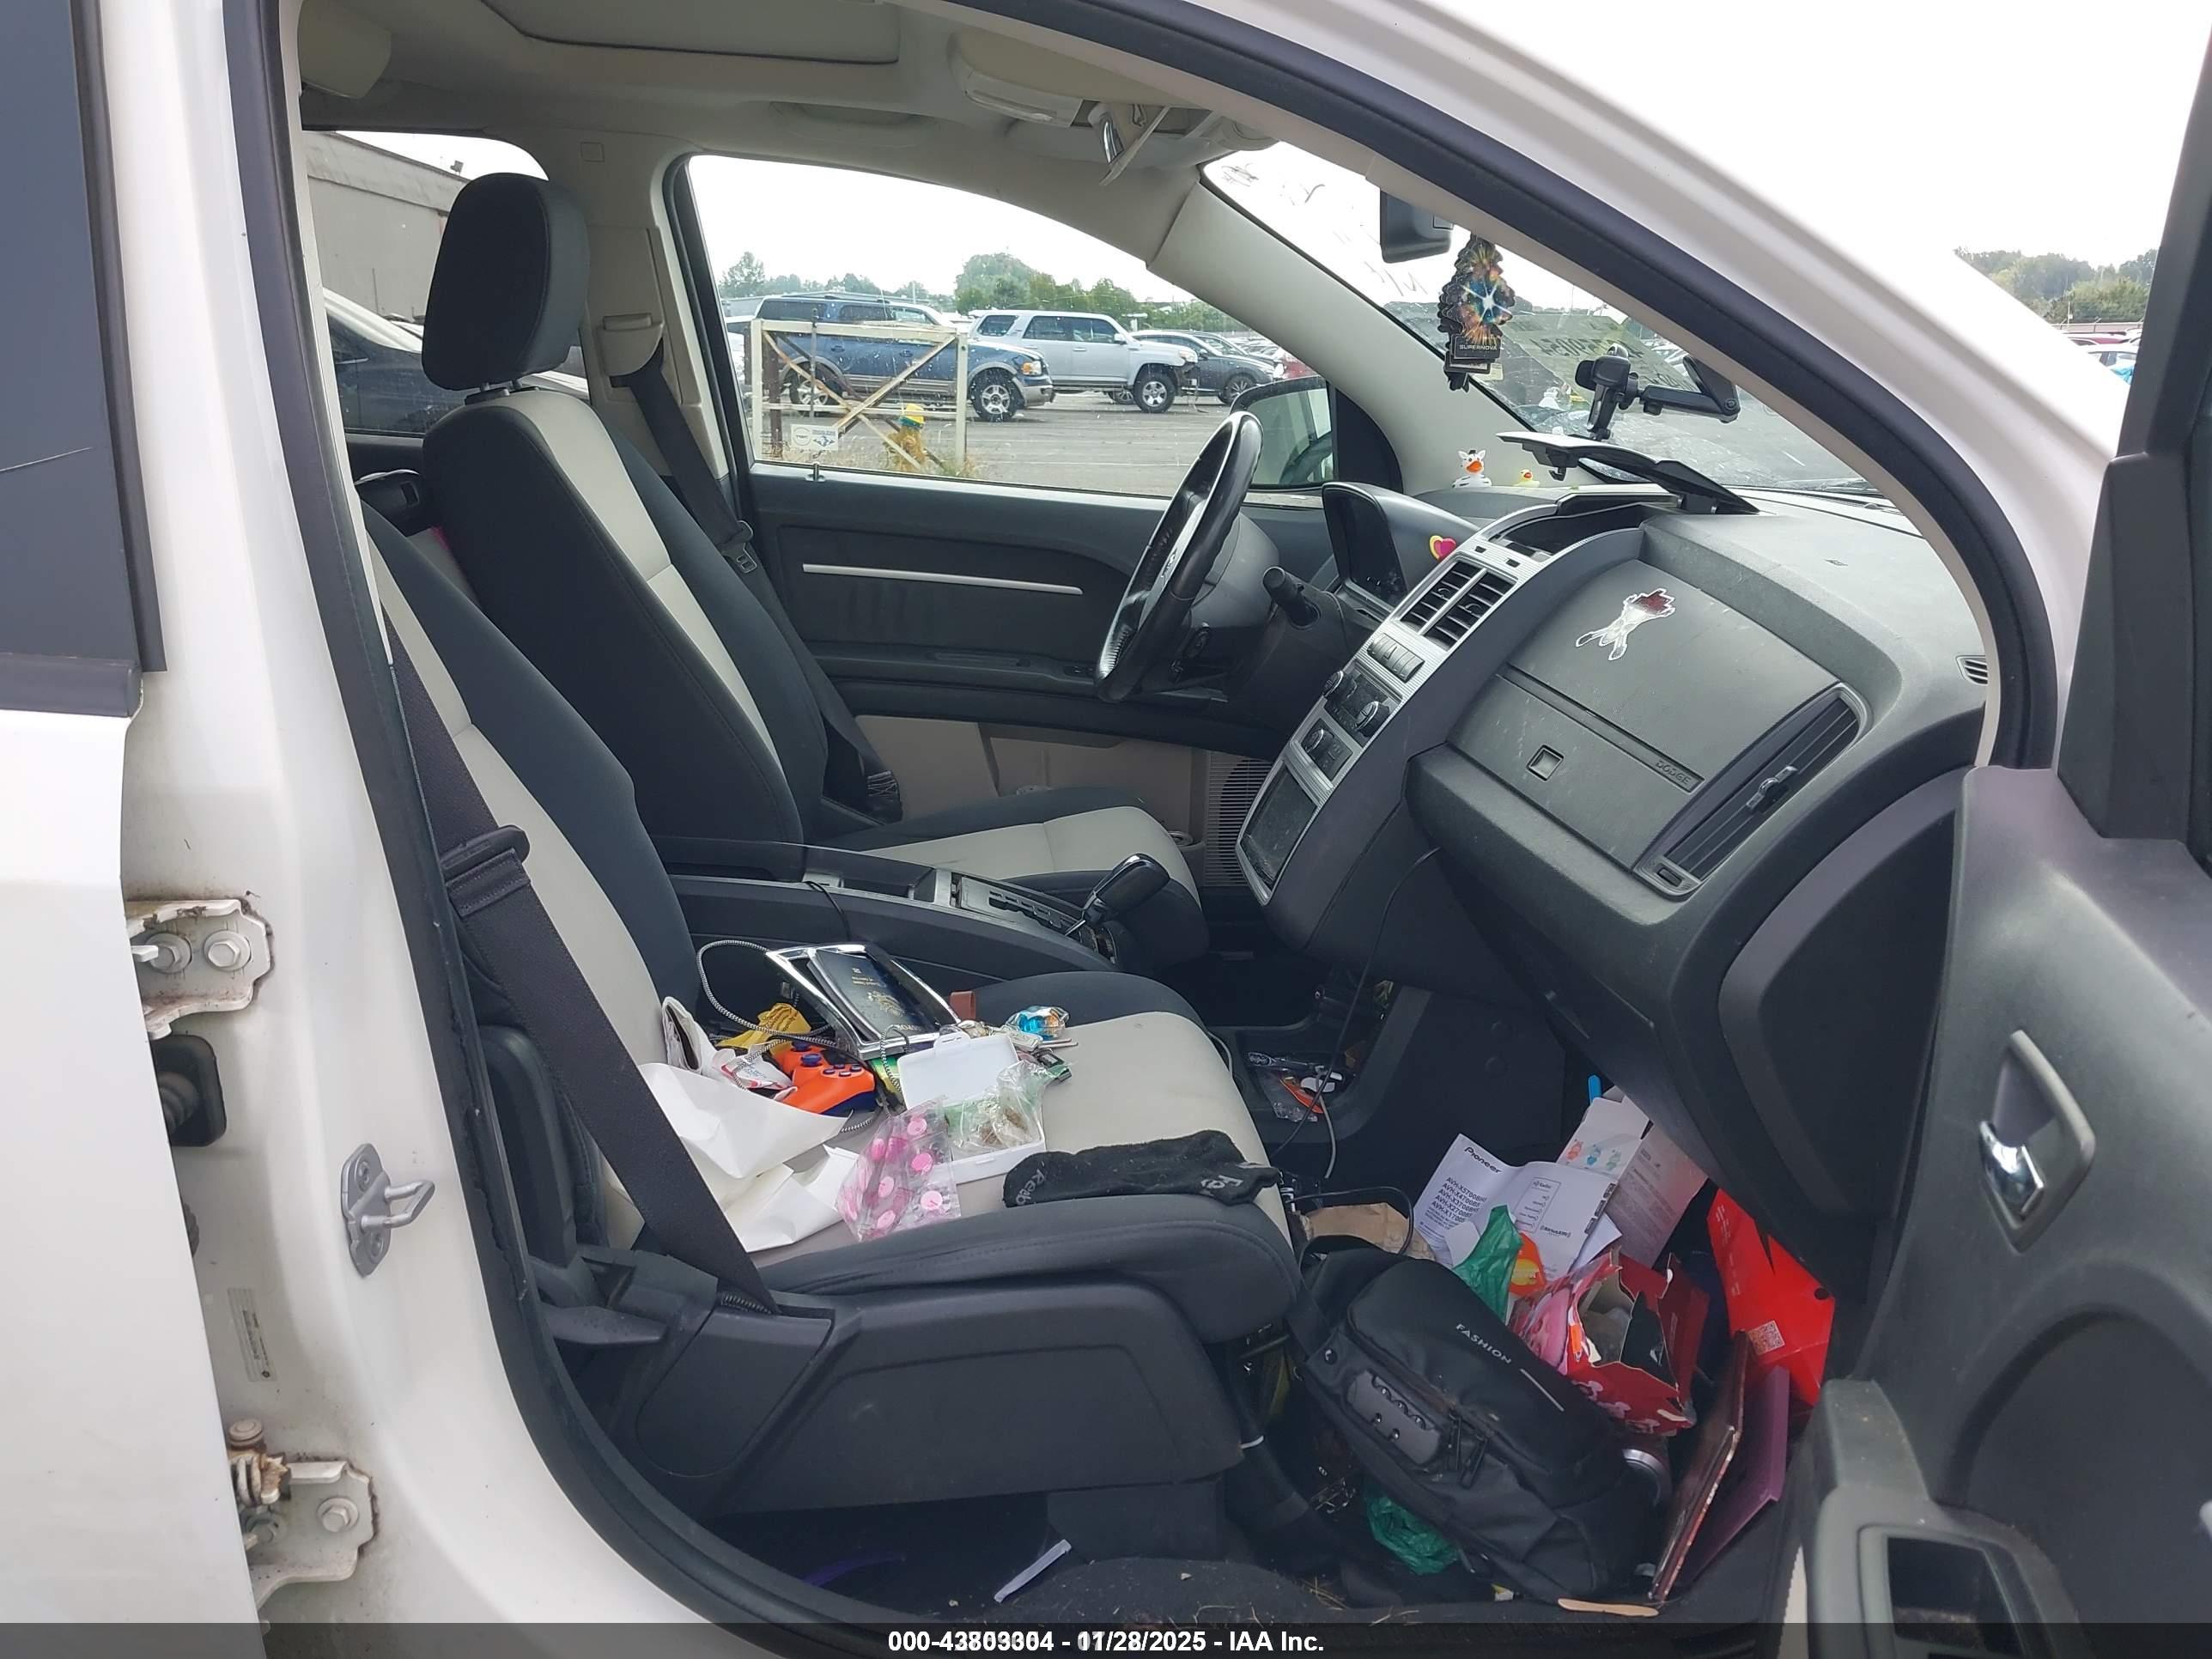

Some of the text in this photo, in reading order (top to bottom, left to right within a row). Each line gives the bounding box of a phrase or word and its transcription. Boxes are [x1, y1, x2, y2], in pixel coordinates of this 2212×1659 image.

[1655, 760, 1692, 785] DODGE
[1464, 1146, 1502, 1173] Pioneer
[1455, 1323, 1512, 1364] FASHION
